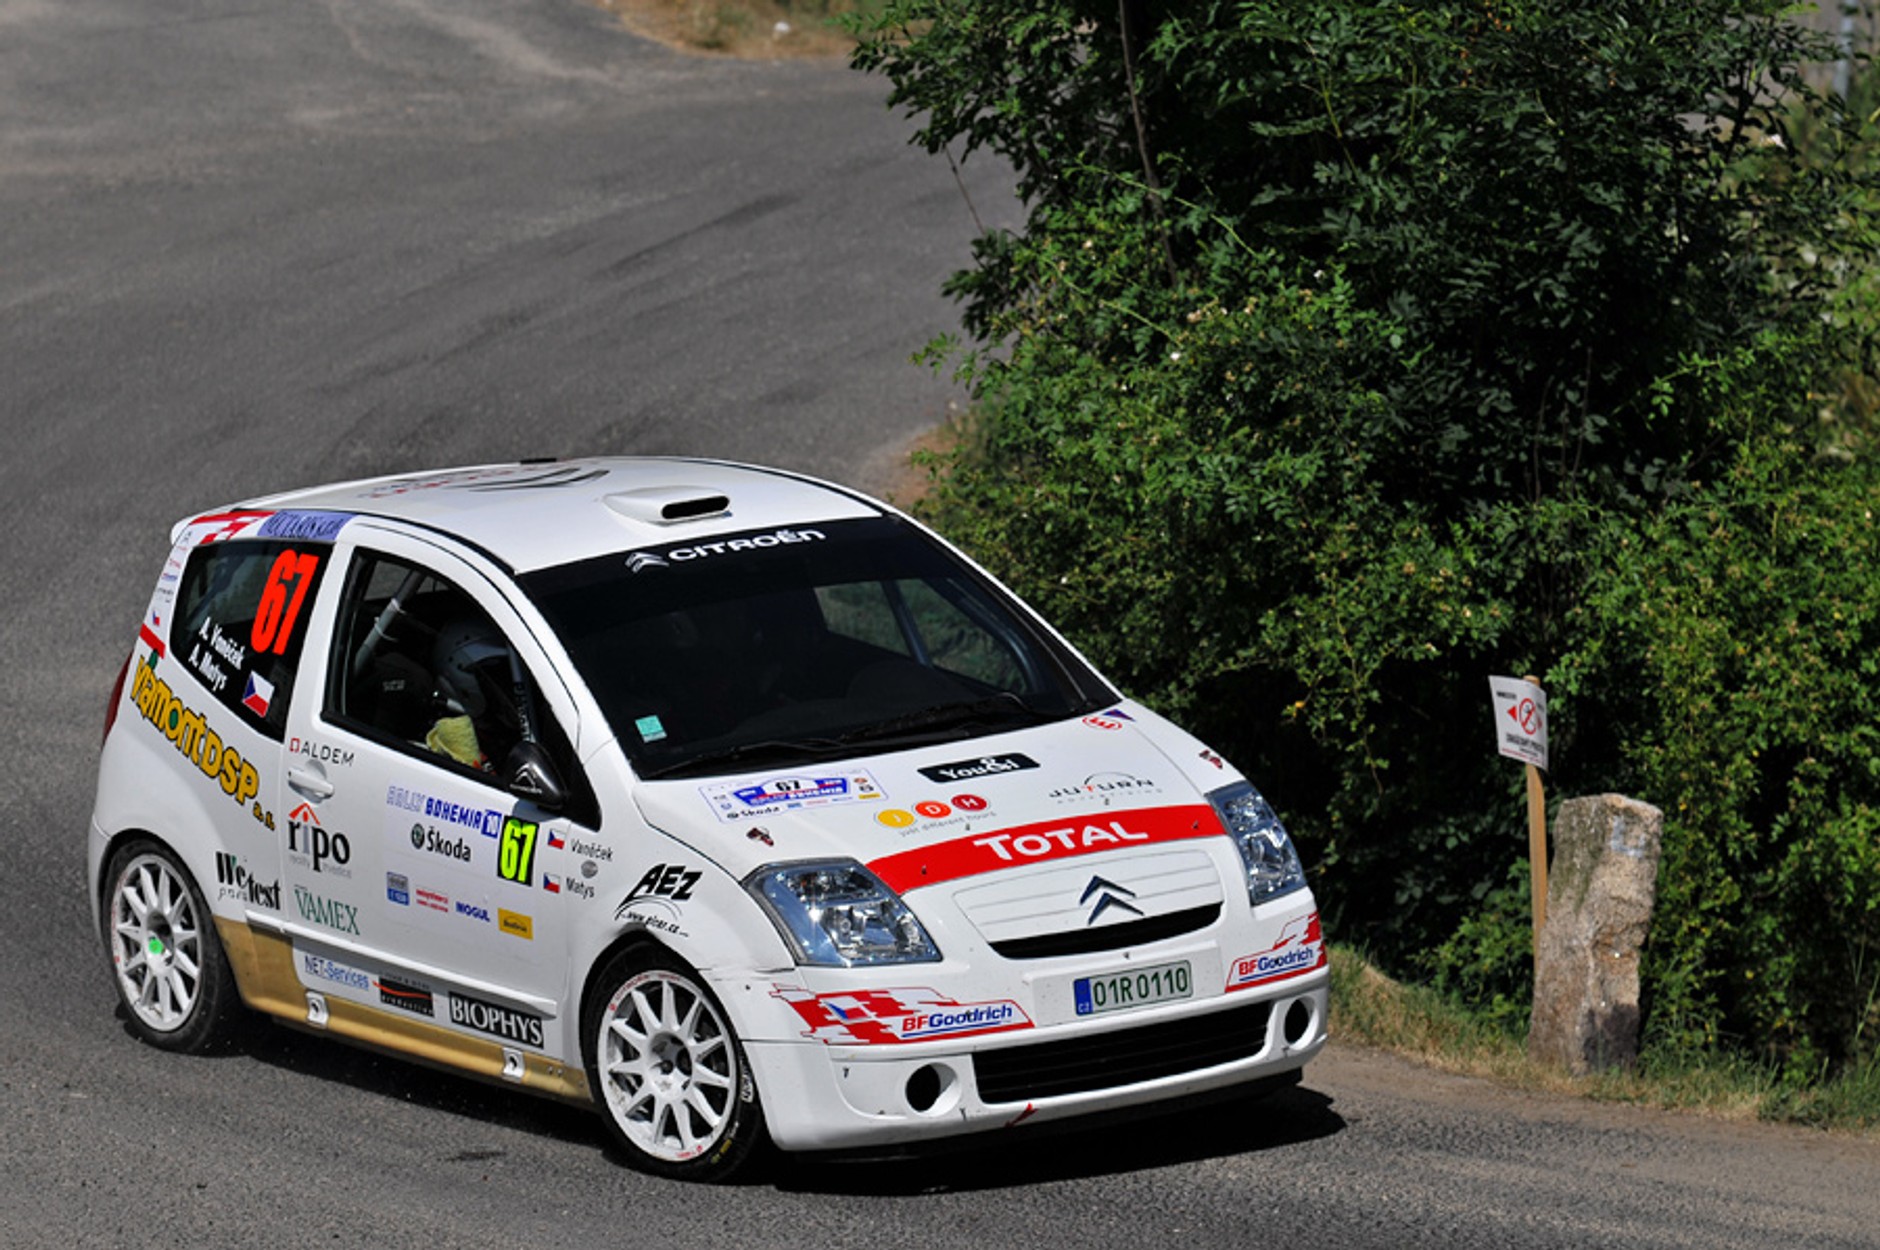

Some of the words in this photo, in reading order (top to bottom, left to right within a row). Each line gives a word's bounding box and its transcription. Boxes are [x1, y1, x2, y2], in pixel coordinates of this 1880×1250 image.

[250, 549, 319, 655] 67
[301, 741, 355, 767] ALDEM
[774, 780, 801, 792] 67
[287, 810, 351, 872] ripo
[427, 825, 472, 862] Škoda
[500, 818, 538, 884] 67
[972, 821, 1149, 861] TOTAL
[614, 863, 703, 906] AEZ
[293, 887, 361, 936] VAMEX
[455, 901, 491, 922] MOGUL
[1238, 946, 1314, 976] BFGoodrich
[451, 996, 543, 1045] BIOPHYS
[902, 1004, 1013, 1032] BFGoodrich
